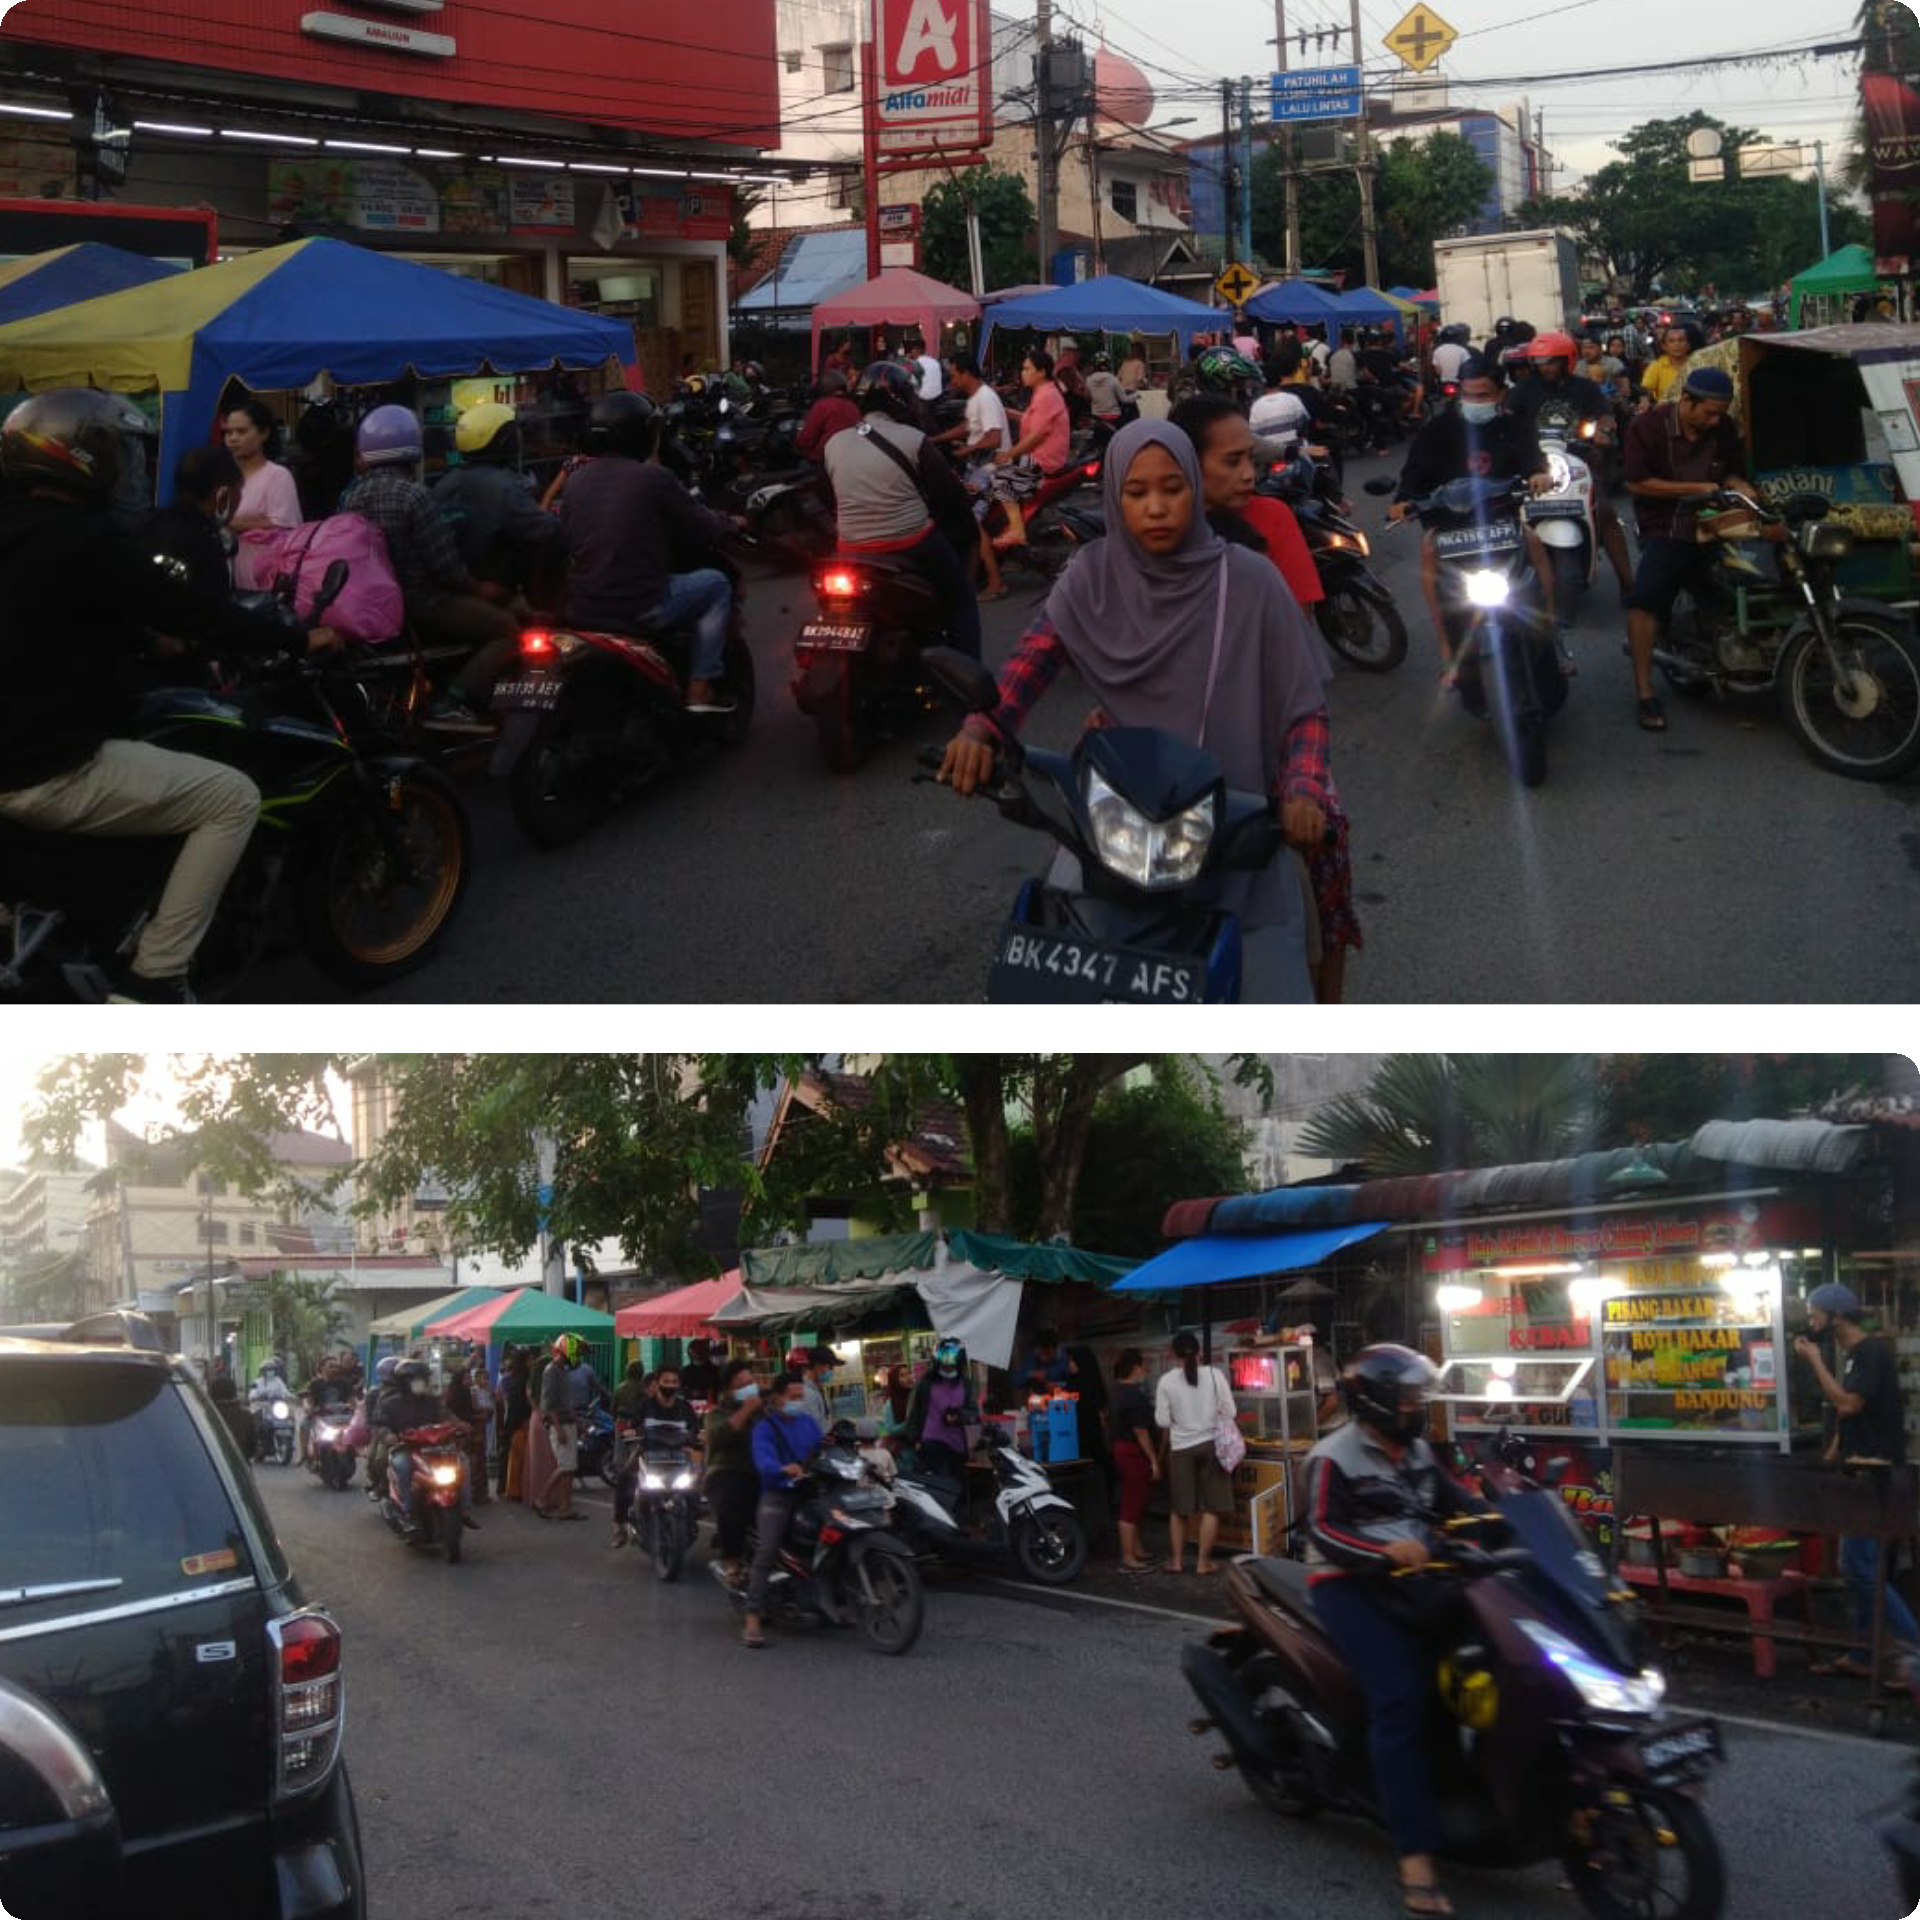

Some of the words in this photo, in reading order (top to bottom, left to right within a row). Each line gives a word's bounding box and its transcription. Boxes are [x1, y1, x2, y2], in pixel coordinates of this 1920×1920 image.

[1283, 73, 1347, 88] PATUHILAH
[885, 83, 970, 112] Alfamidi
[1281, 102, 1310, 115] LALU
[1313, 98, 1349, 112] LINTAS
[1130, 962, 1191, 999] AFS
[1605, 1299, 1659, 1323] PISANG
[1660, 1295, 1715, 1318] BAKAR
[1631, 1328, 1673, 1350] ROTI
[1675, 1327, 1743, 1349] BAKAR
[1674, 1389, 1770, 1411] BANDUNG
[202, 1643, 231, 1659] S
